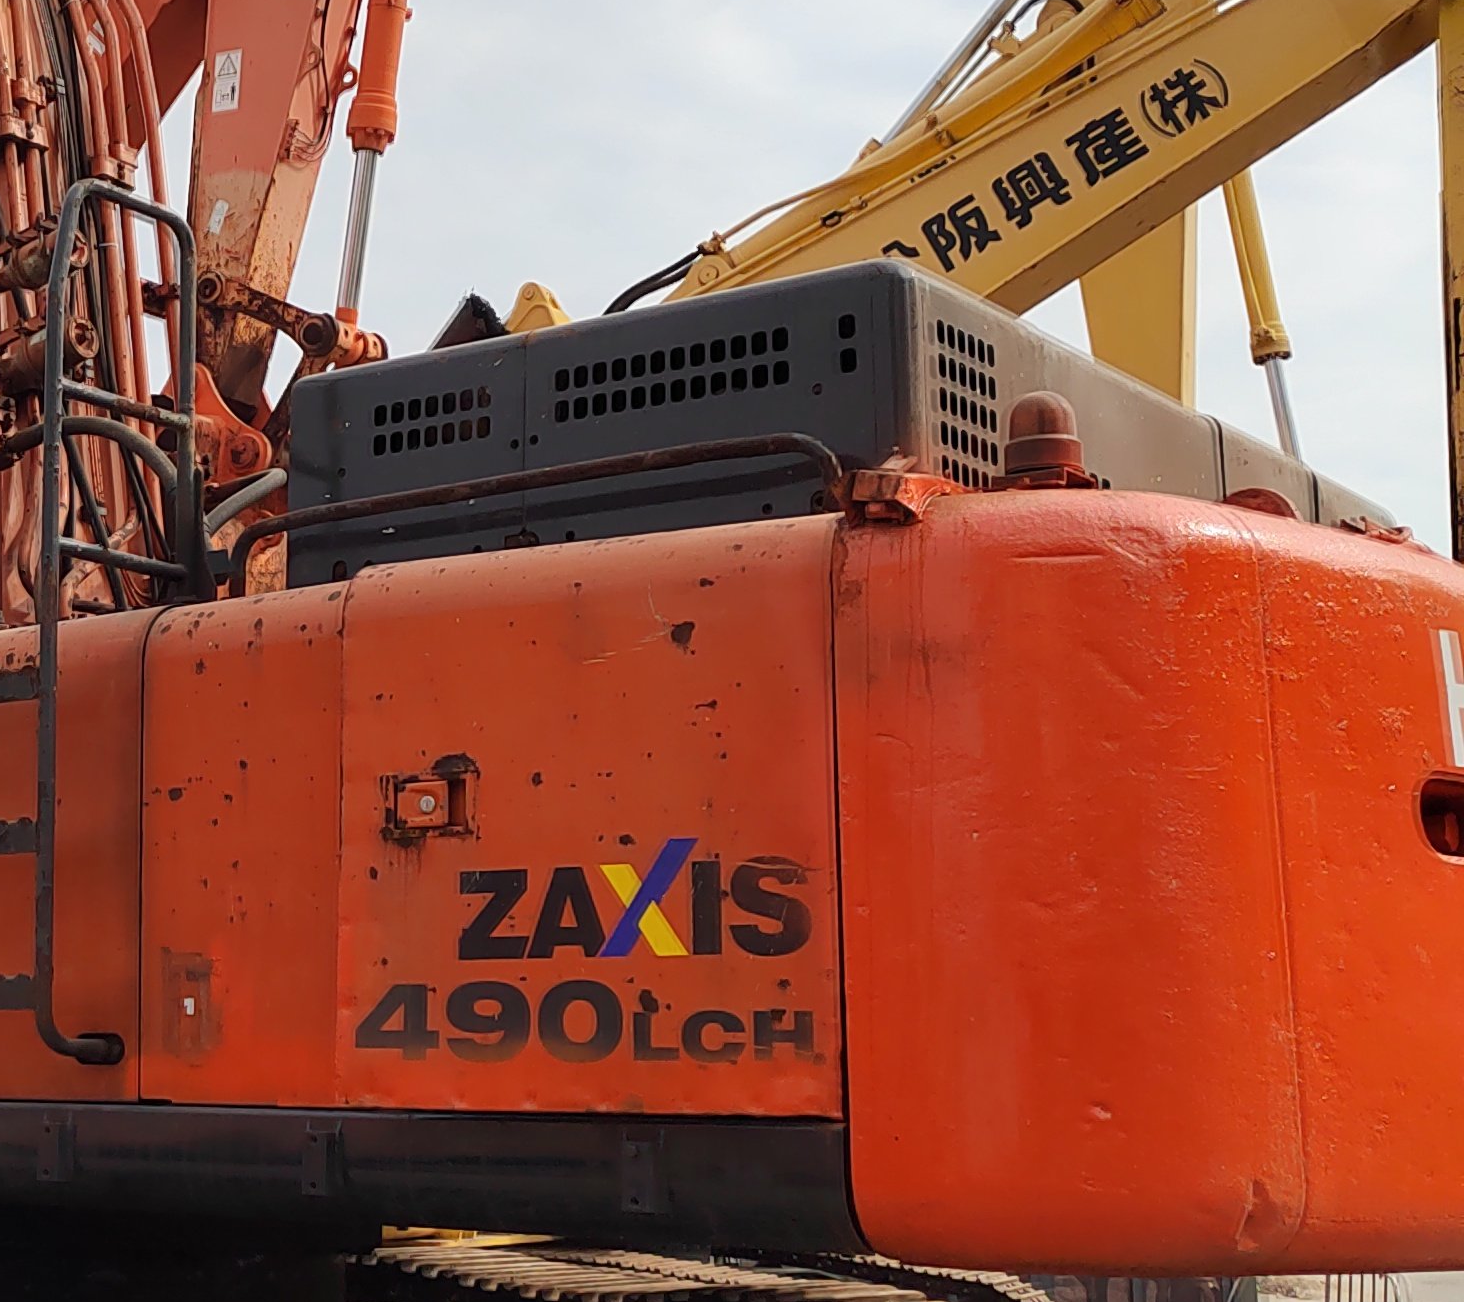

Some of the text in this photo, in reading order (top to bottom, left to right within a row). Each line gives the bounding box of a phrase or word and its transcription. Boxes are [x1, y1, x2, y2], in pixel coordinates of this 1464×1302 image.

[882, 58, 1229, 273] 阪興産(株)
[458, 838, 812, 960] ZAXIS
[354, 980, 815, 1064] 490LCH
